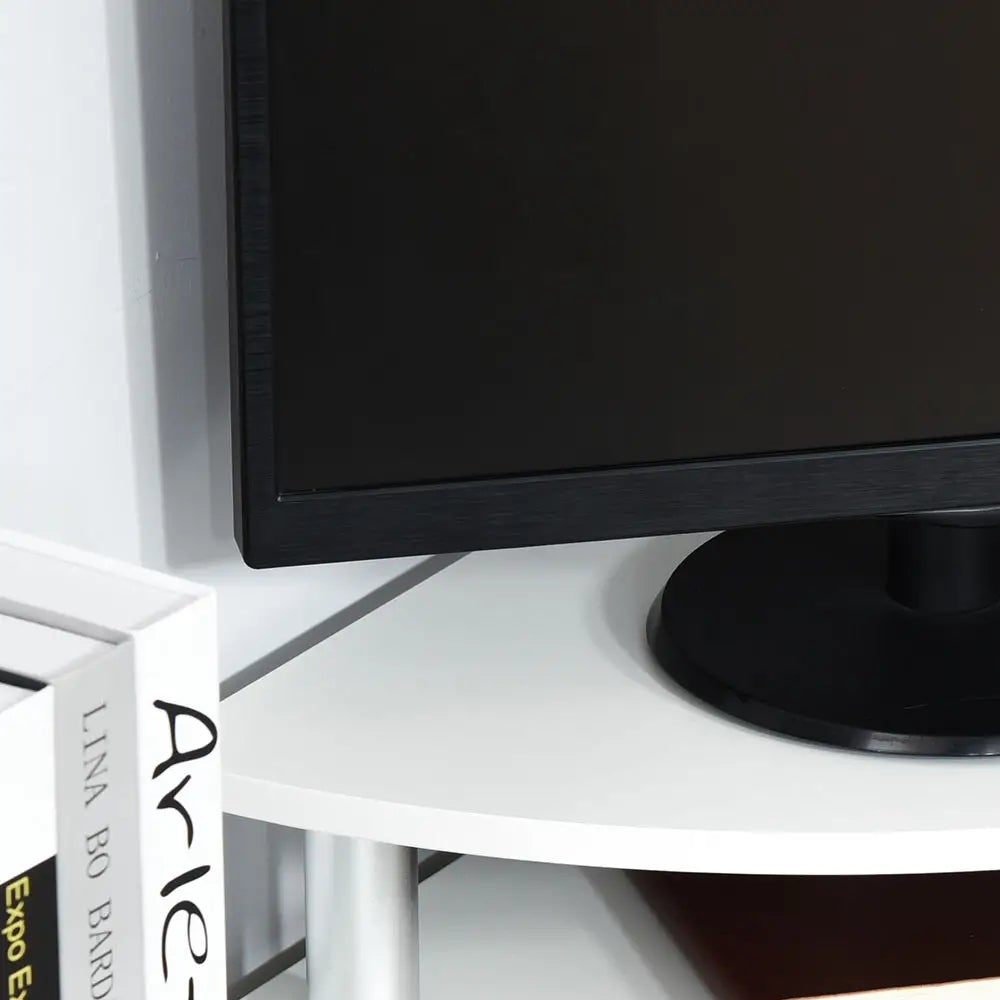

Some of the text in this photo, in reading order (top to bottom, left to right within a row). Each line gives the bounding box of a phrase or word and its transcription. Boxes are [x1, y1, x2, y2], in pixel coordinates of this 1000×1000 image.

[82, 702, 108, 807] LINA
[85, 825, 111, 880] BO
[1, 876, 30, 962] Expo
